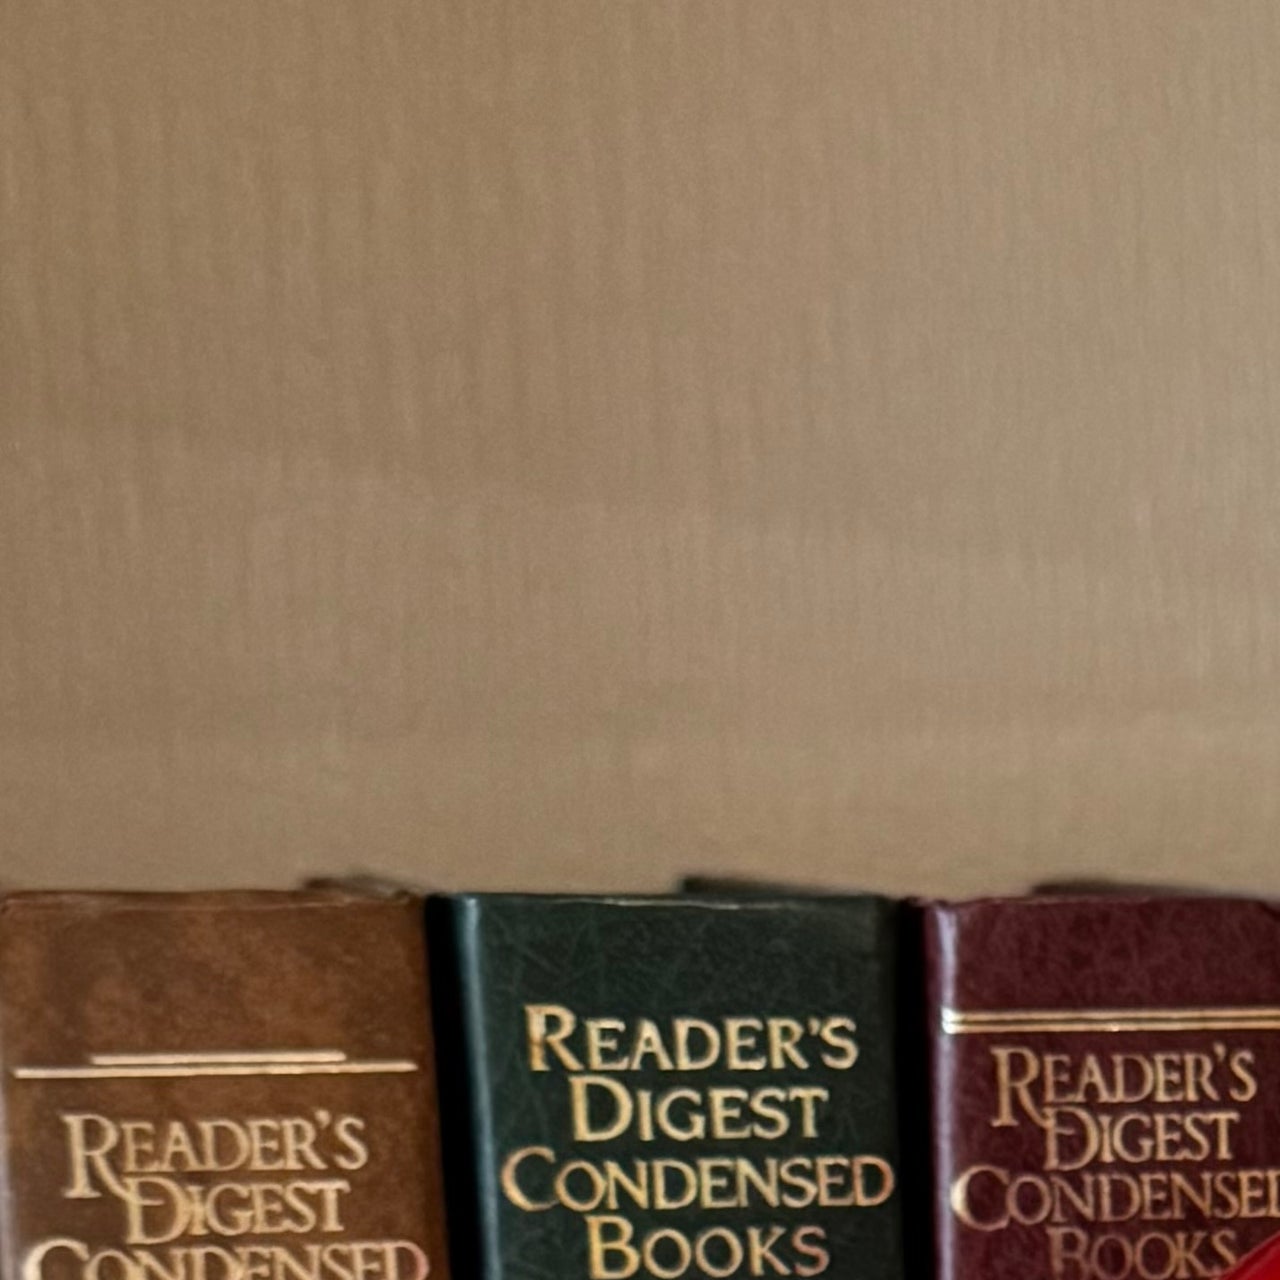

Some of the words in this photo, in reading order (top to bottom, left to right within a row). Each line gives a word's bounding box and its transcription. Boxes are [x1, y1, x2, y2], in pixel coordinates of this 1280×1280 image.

[526, 1004, 859, 1072] READER'S
[570, 1076, 828, 1141] DIGEST
[992, 1044, 1258, 1128] READER'S
[63, 1108, 368, 1200] READER'S
[1042, 1110, 1239, 1172] DIGEST
[125, 1178, 350, 1246] DIGEST
[502, 1147, 894, 1213] CONDENSED
[586, 1215, 830, 1280] BOOKS
